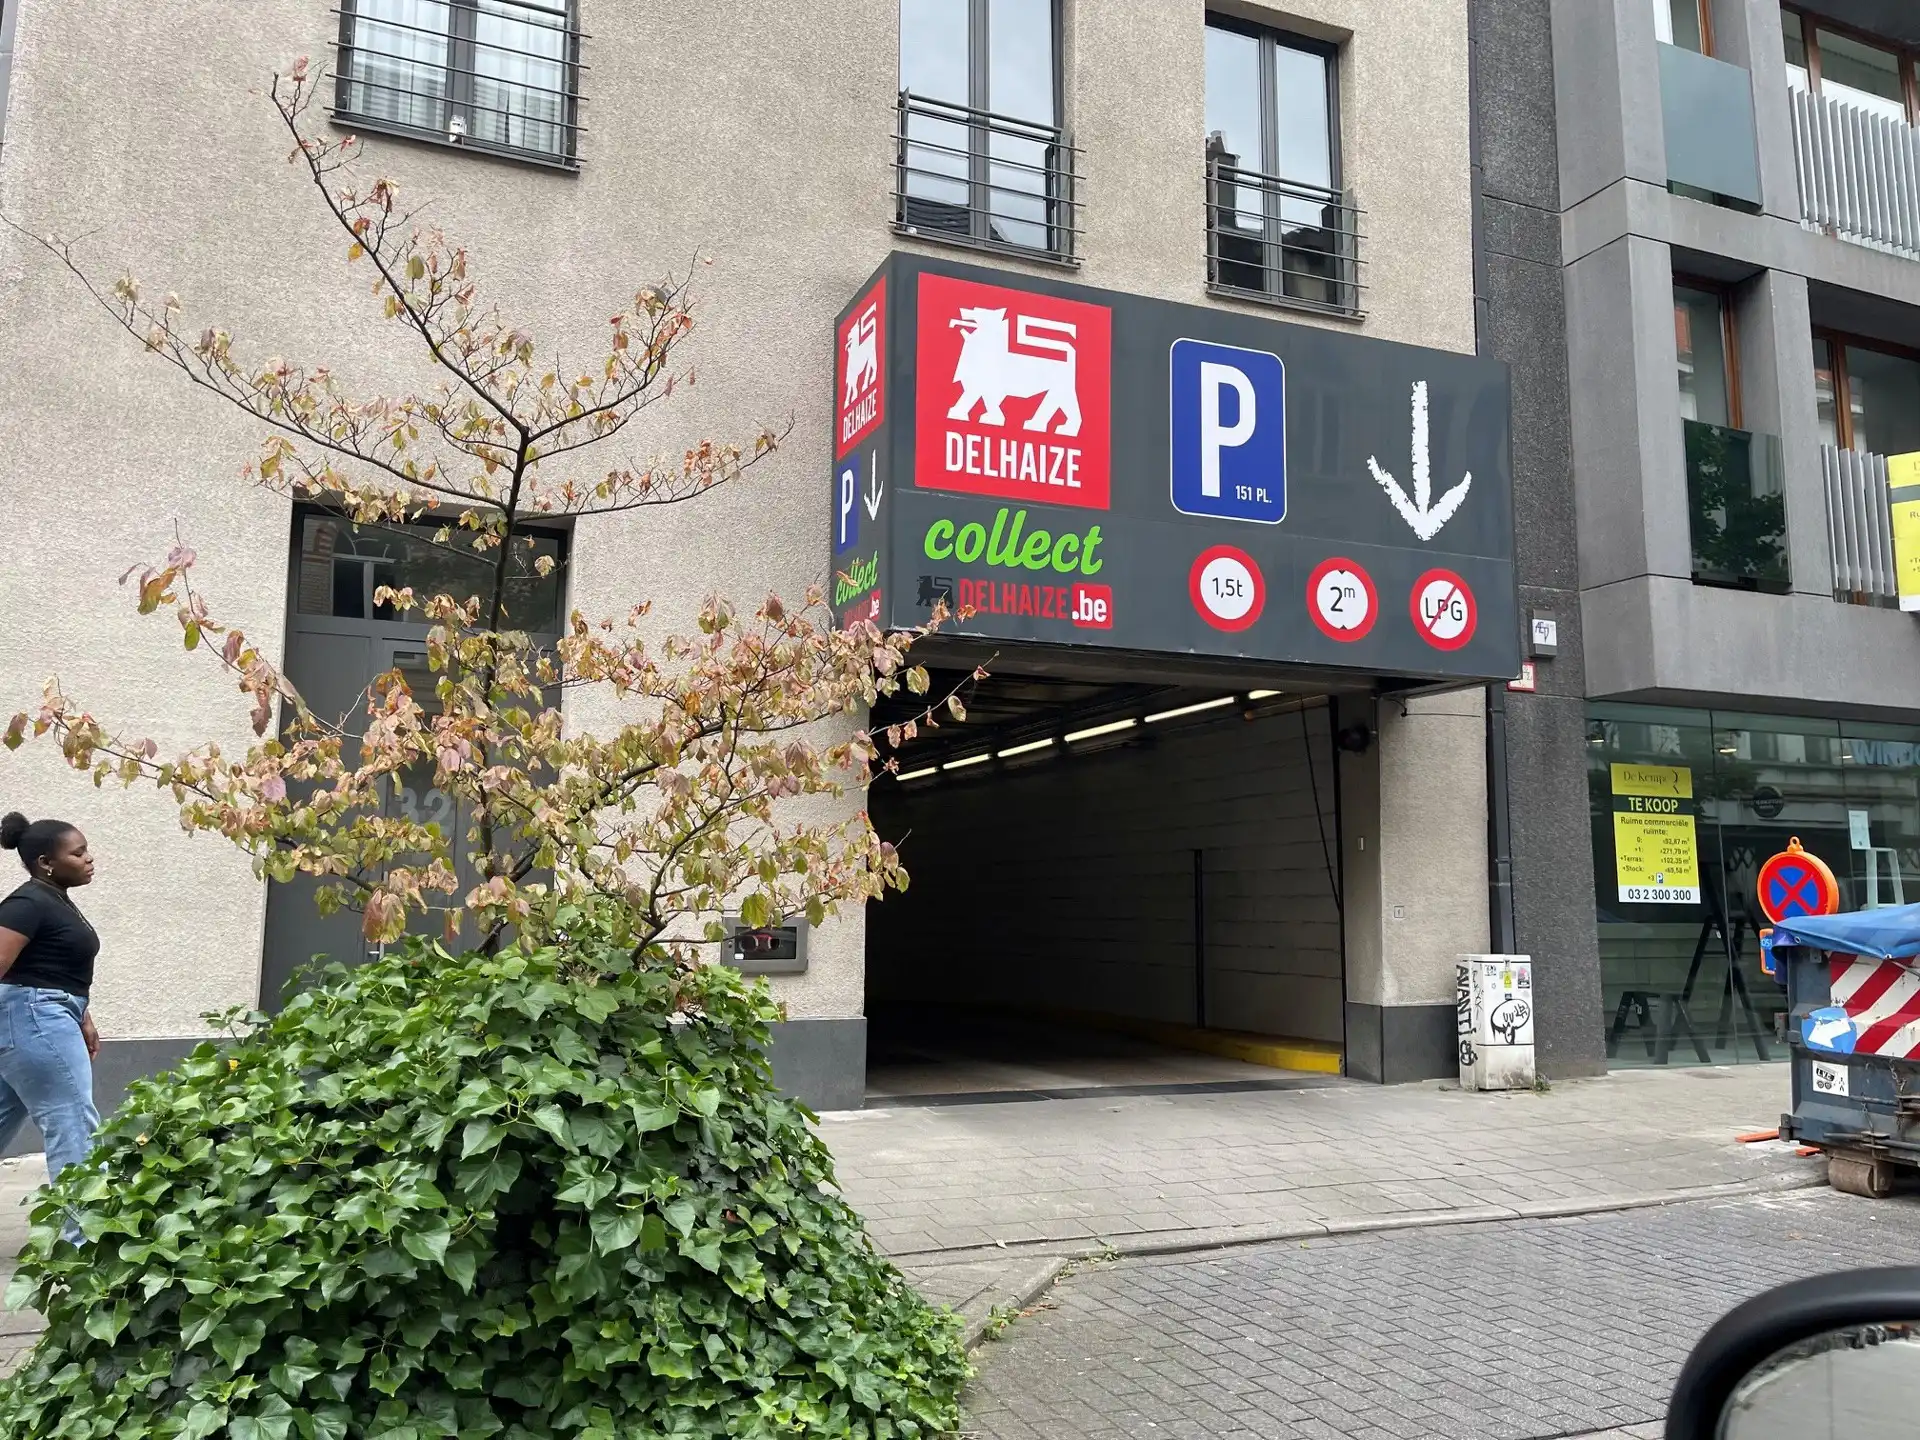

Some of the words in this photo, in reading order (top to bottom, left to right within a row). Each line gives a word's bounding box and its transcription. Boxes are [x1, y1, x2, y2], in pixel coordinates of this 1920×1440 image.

[842, 388, 877, 443] DELHAIZE
[1200, 361, 1256, 498] P
[945, 431, 1082, 488] DELHAIZE
[840, 469, 854, 544] P
[1235, 485, 1252, 501] 151
[1256, 487, 1272, 504] PL.
[924, 508, 1103, 575] collect
[1212, 577, 1243, 599] 1,5t
[1424, 597, 1463, 621] LPG
[1628, 797, 1643, 812] TE
[1645, 797, 1678, 813] KOOP
[1628, 889, 1641, 899] 03
[1643, 889, 1649, 899] 2
[1652, 889, 1671, 900] 300
[1672, 889, 1691, 901] 300
